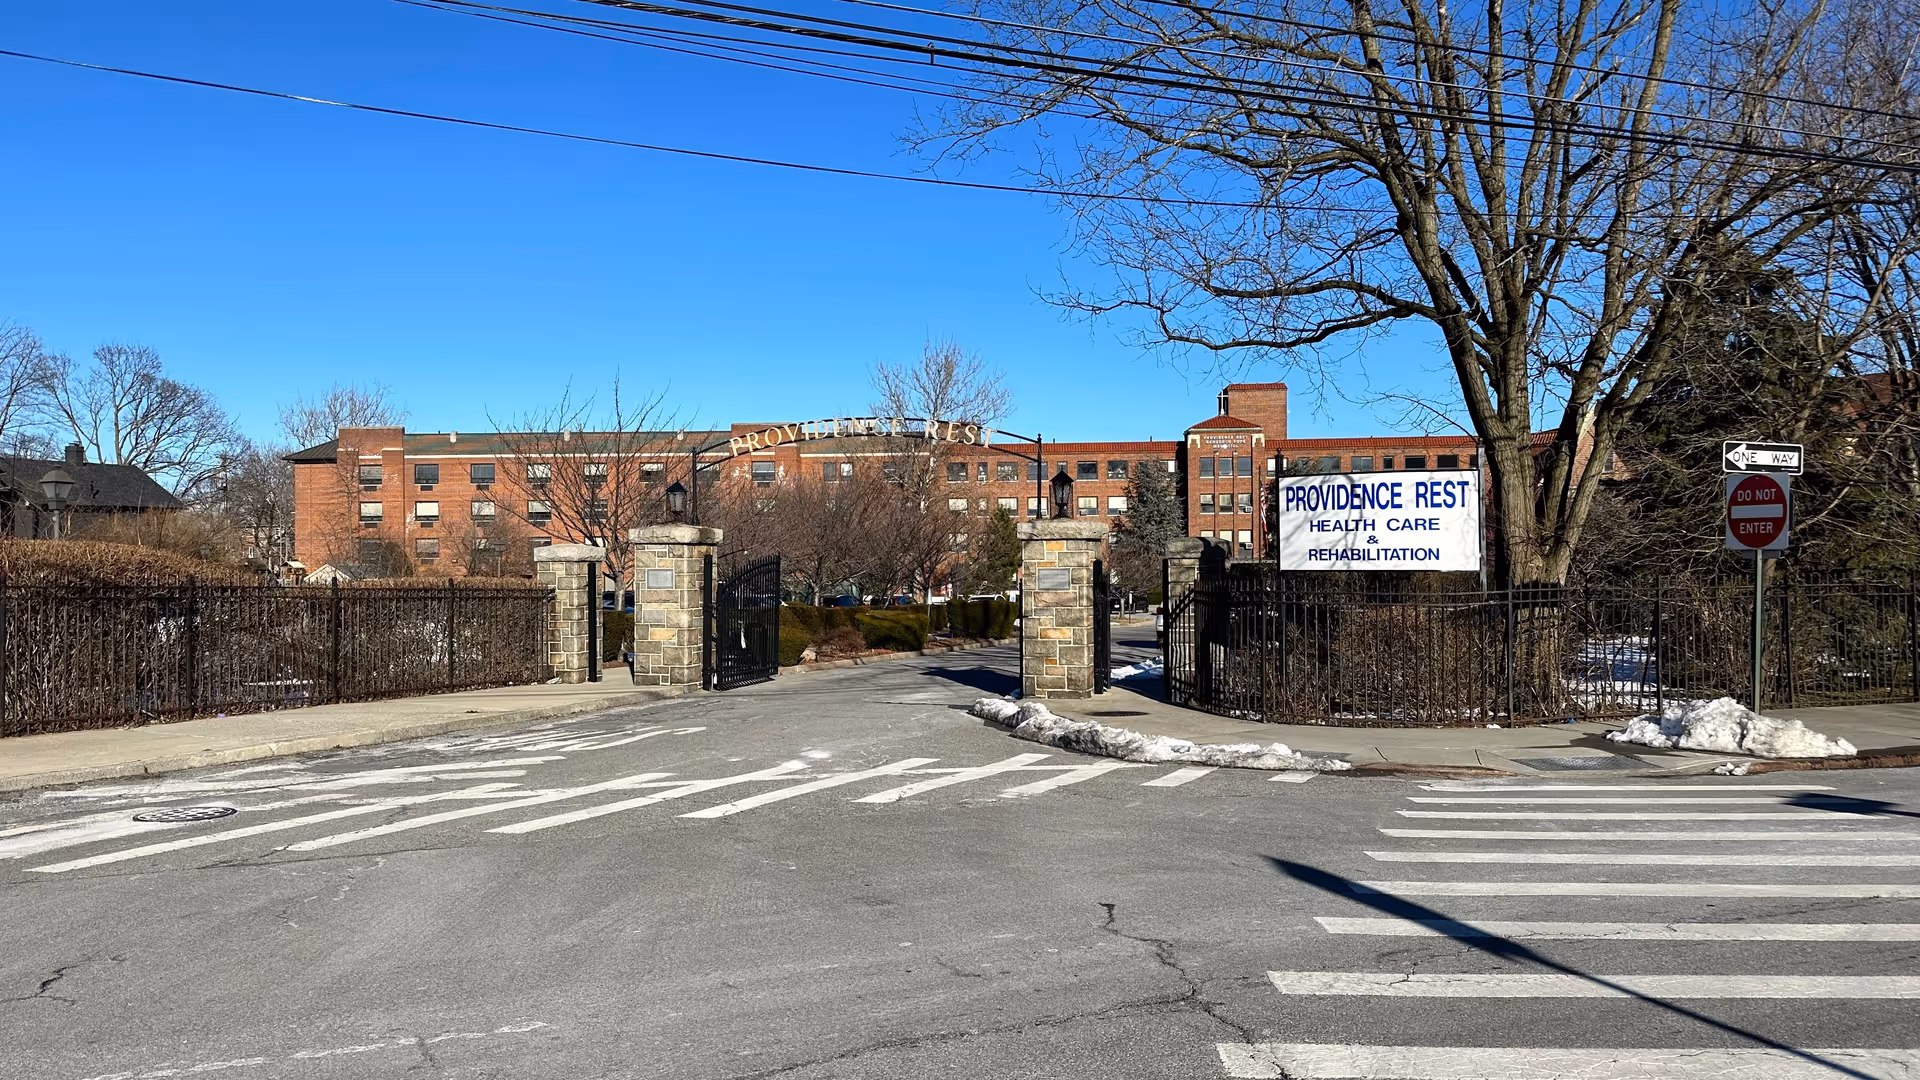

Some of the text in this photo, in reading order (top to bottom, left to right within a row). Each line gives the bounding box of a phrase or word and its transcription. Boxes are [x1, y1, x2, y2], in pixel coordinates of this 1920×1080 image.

[730, 417, 998, 457] PROVIDENCE REST
[1733, 451, 1795, 464] ONE WAY
[1285, 480, 1469, 511] PROVIDENCE REST
[1737, 488, 1777, 501] DO NOT
[1309, 518, 1441, 532] HEALTH CARE
[1739, 522, 1773, 534] ENTER
[1366, 535, 1379, 544] &
[1308, 548, 1440, 561] REHABILITATION
